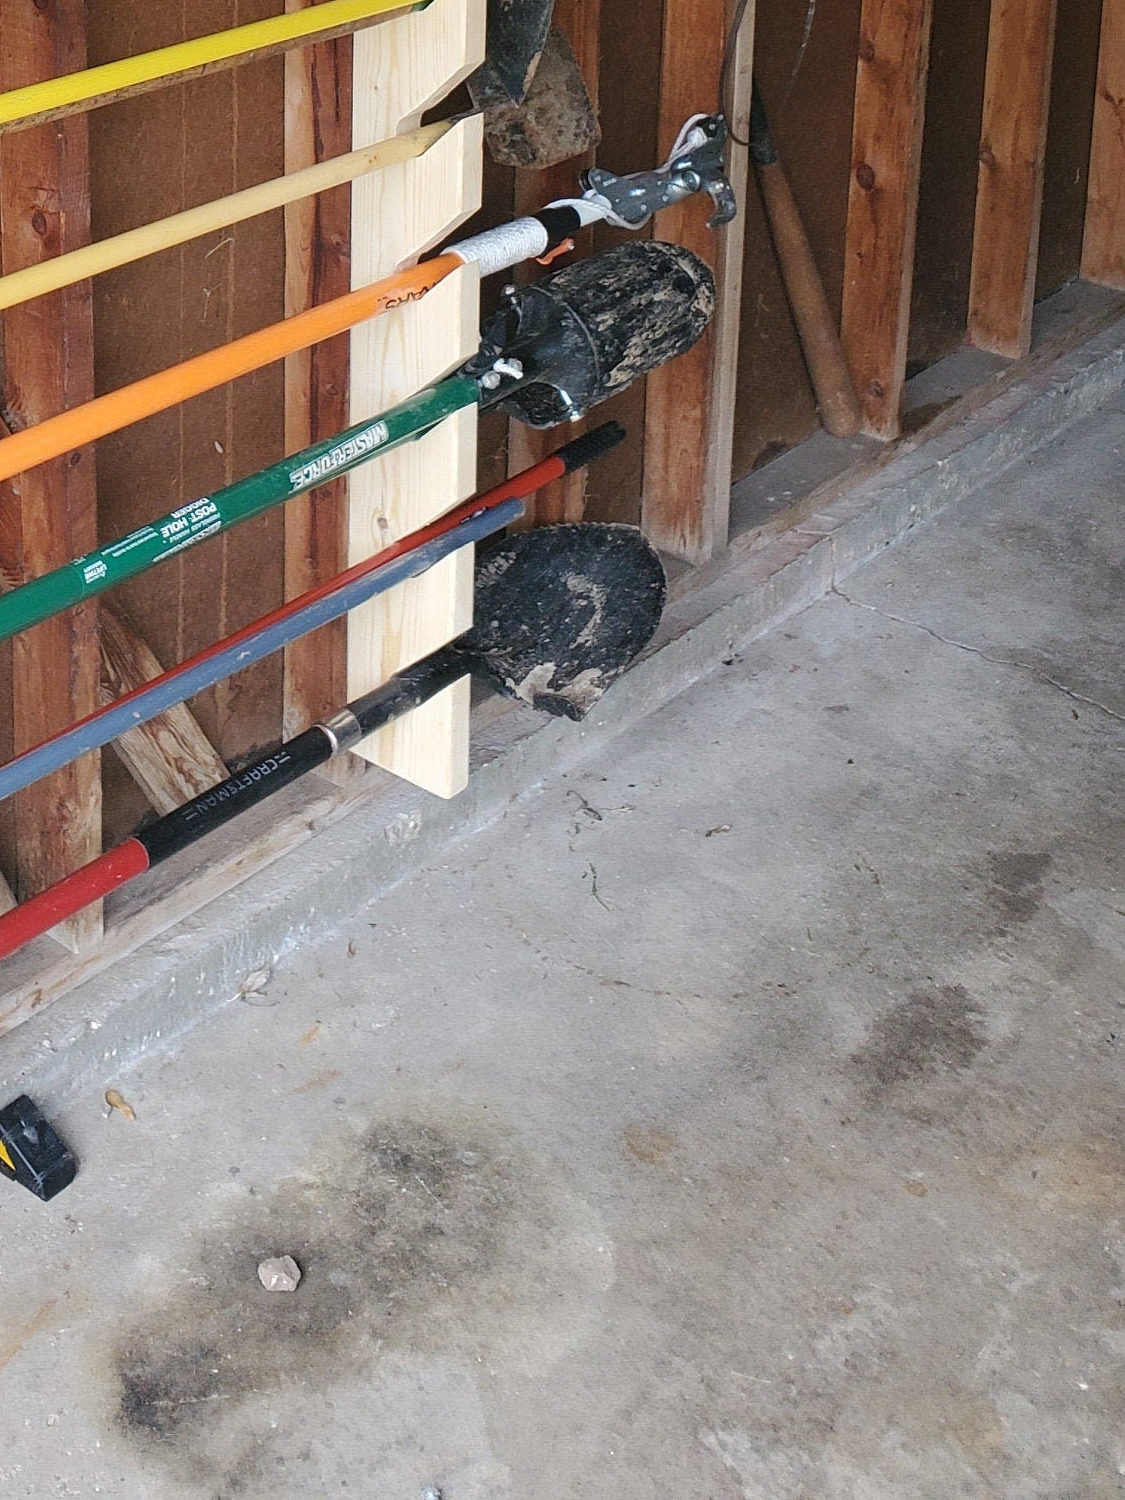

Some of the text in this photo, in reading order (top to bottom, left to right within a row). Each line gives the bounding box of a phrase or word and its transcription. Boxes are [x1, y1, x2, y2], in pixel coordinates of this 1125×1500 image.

[289, 420, 388, 491] MASTERFORCE
[160, 502, 217, 538] POST HOLE
[196, 759, 278, 814] CRAFTSMAN
